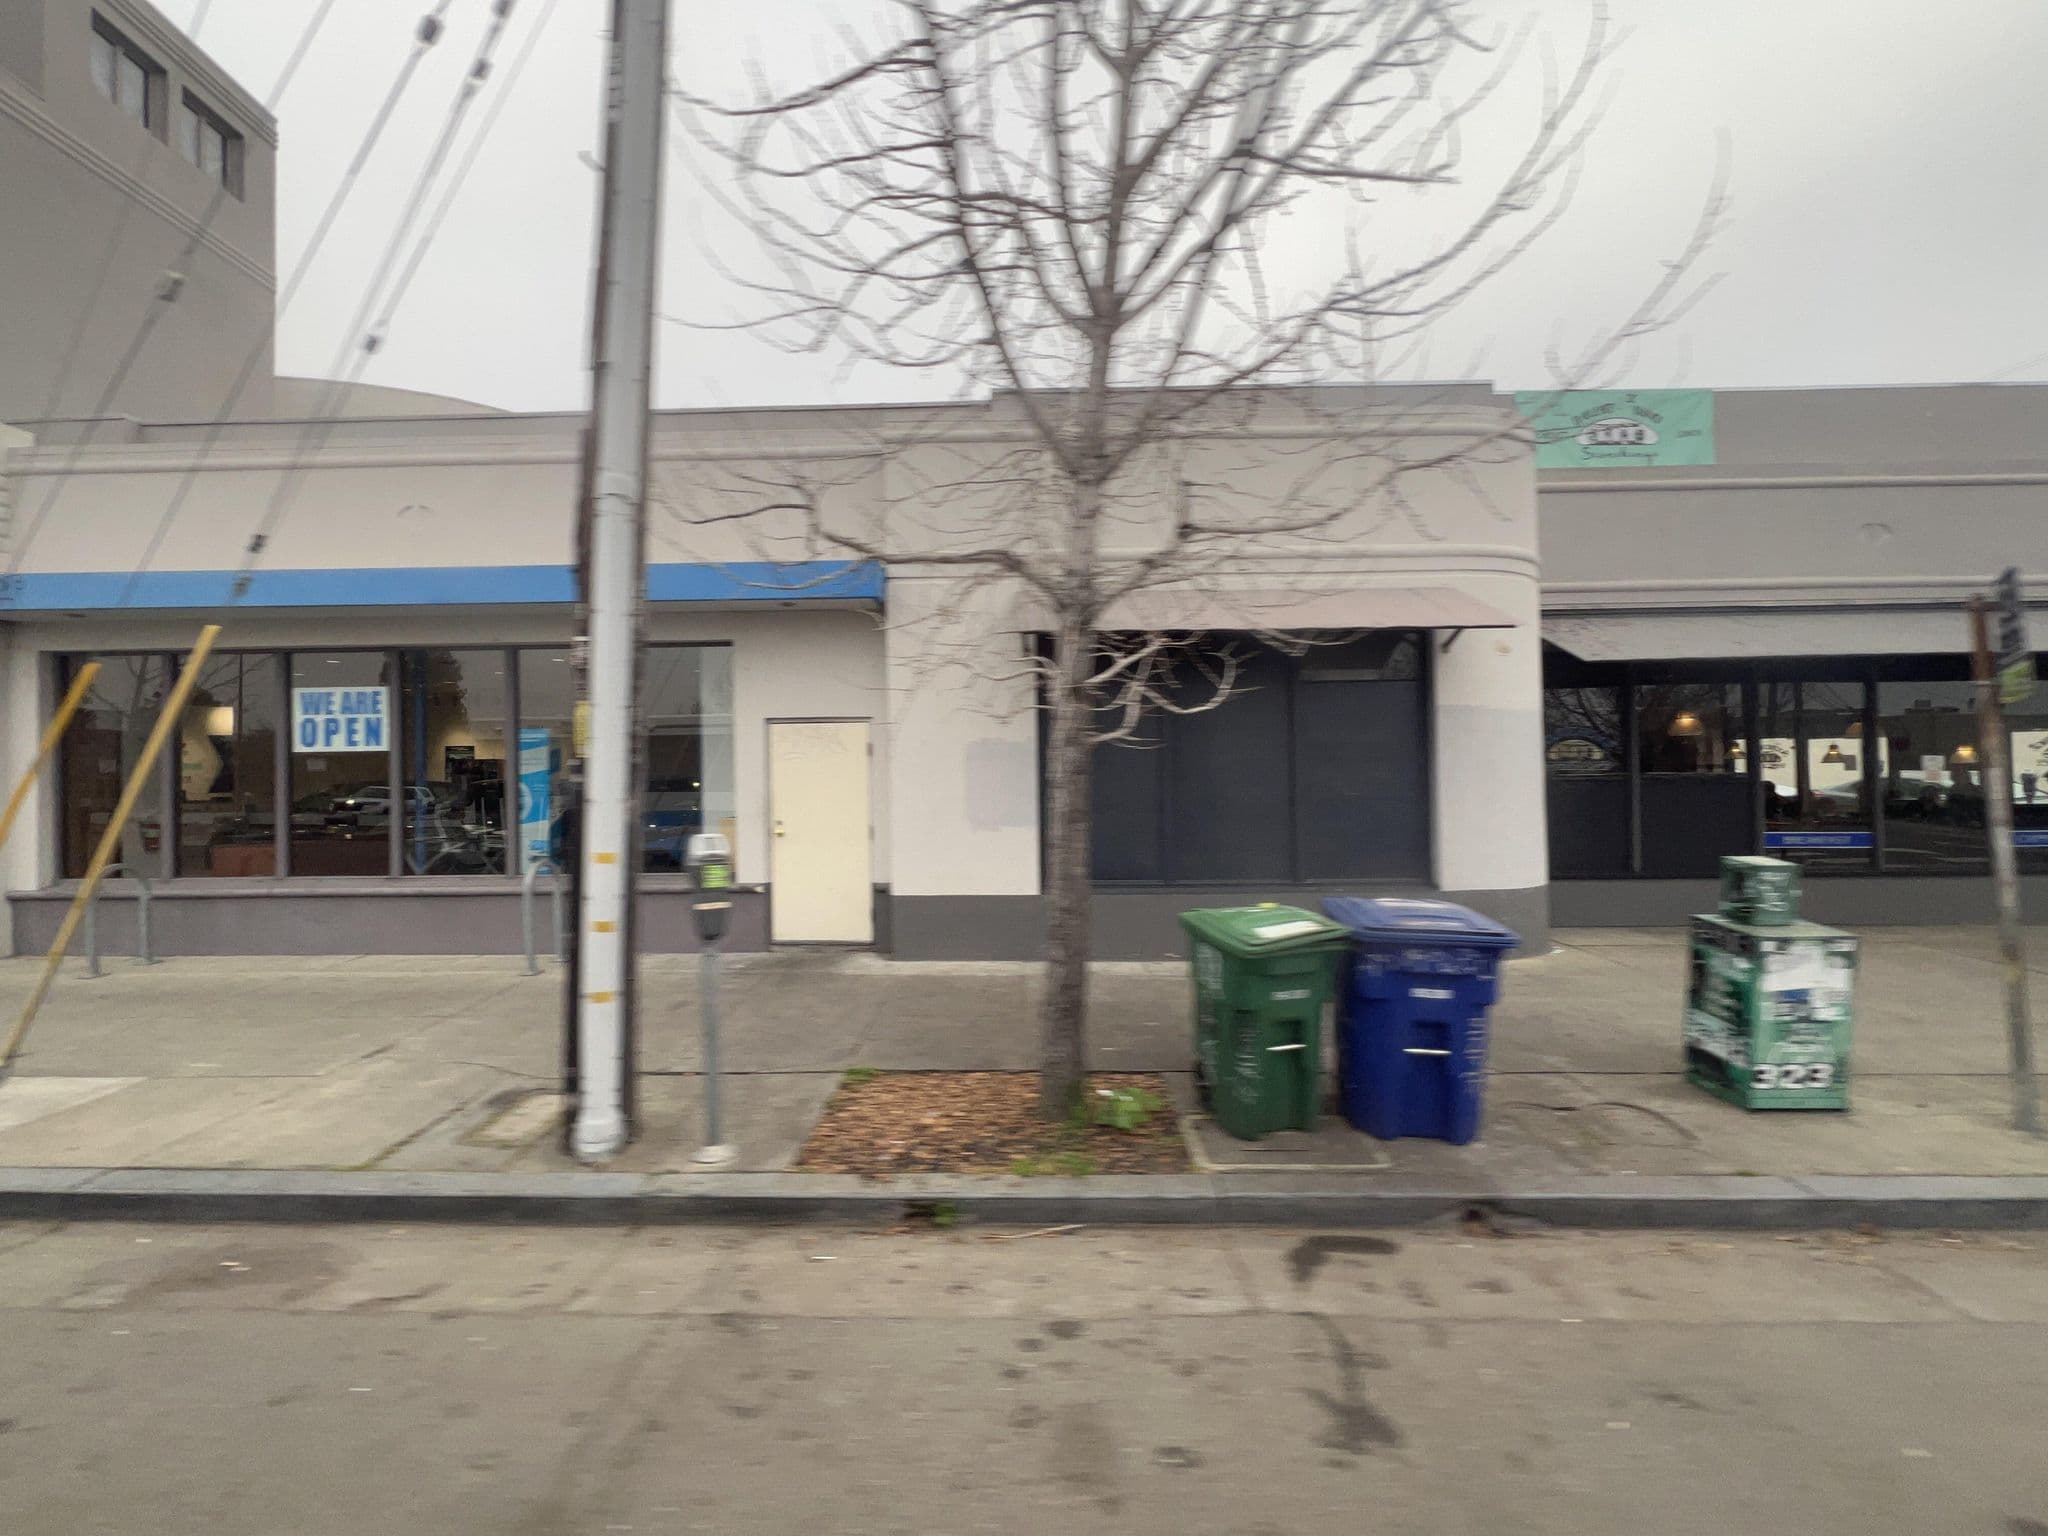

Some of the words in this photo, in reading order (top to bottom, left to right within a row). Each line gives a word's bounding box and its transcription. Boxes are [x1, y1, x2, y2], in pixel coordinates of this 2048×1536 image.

[300, 691, 336, 715] WE
[340, 691, 382, 714] ARE
[301, 717, 382, 747] OPEN
[1749, 1063, 1834, 1089] 323
